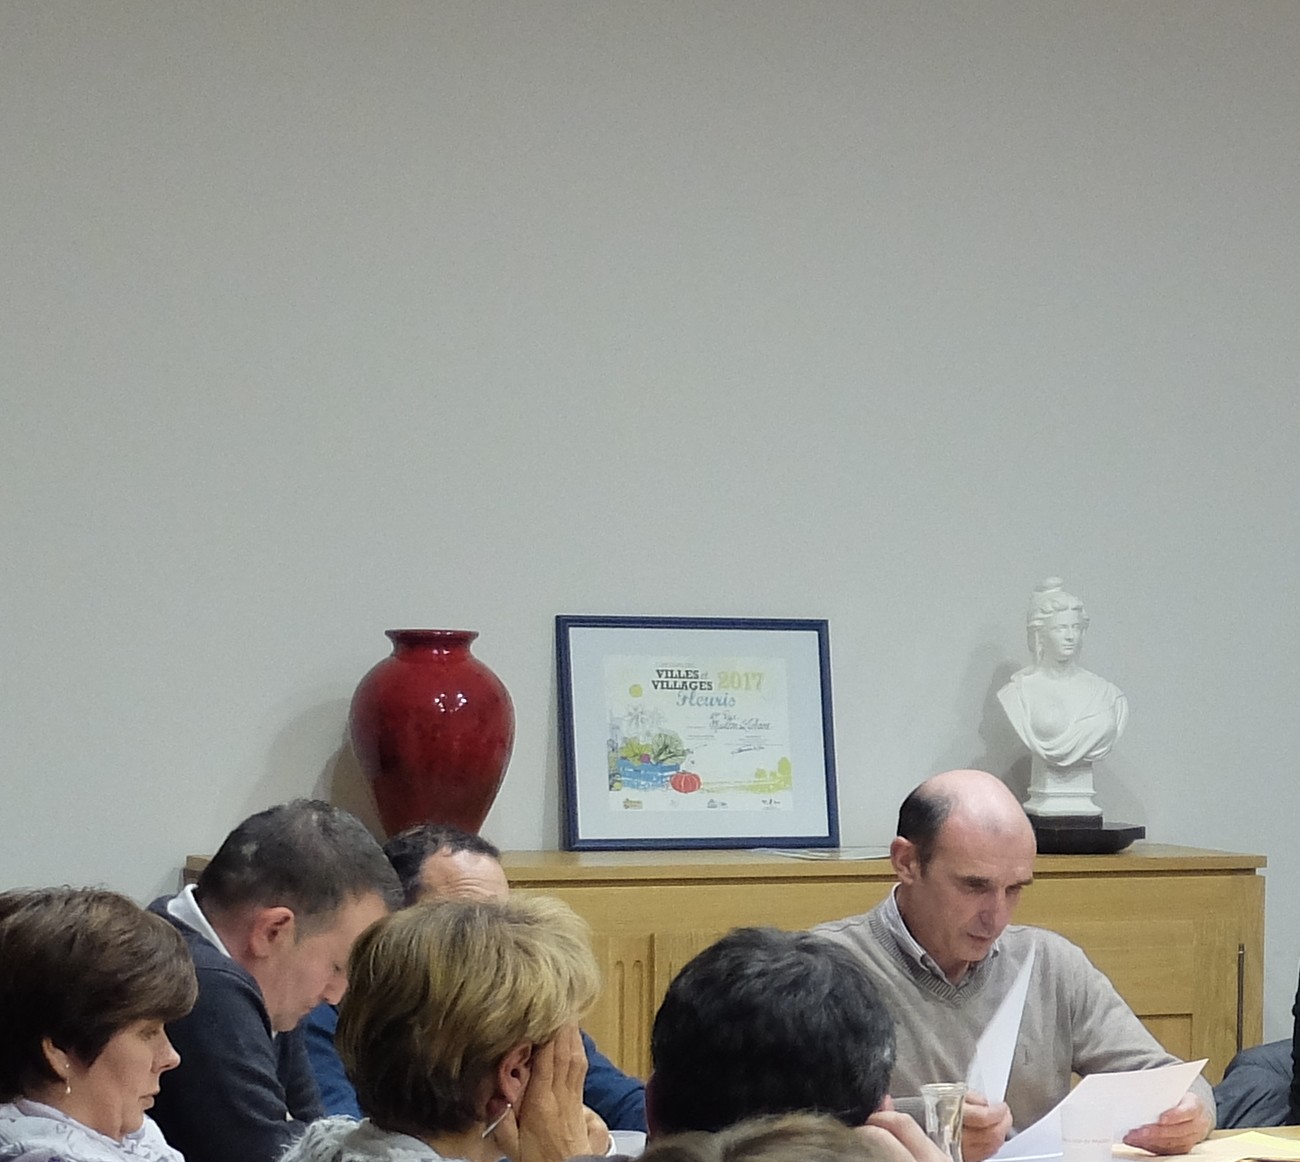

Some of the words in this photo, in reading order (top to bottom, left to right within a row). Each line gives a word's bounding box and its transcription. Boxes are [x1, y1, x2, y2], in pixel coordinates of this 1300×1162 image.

[656, 669, 699, 679] VILLES
[718, 671, 765, 691] 2017
[651, 680, 713, 691] VILLAGES
[676, 690, 736, 707] Fleuris
